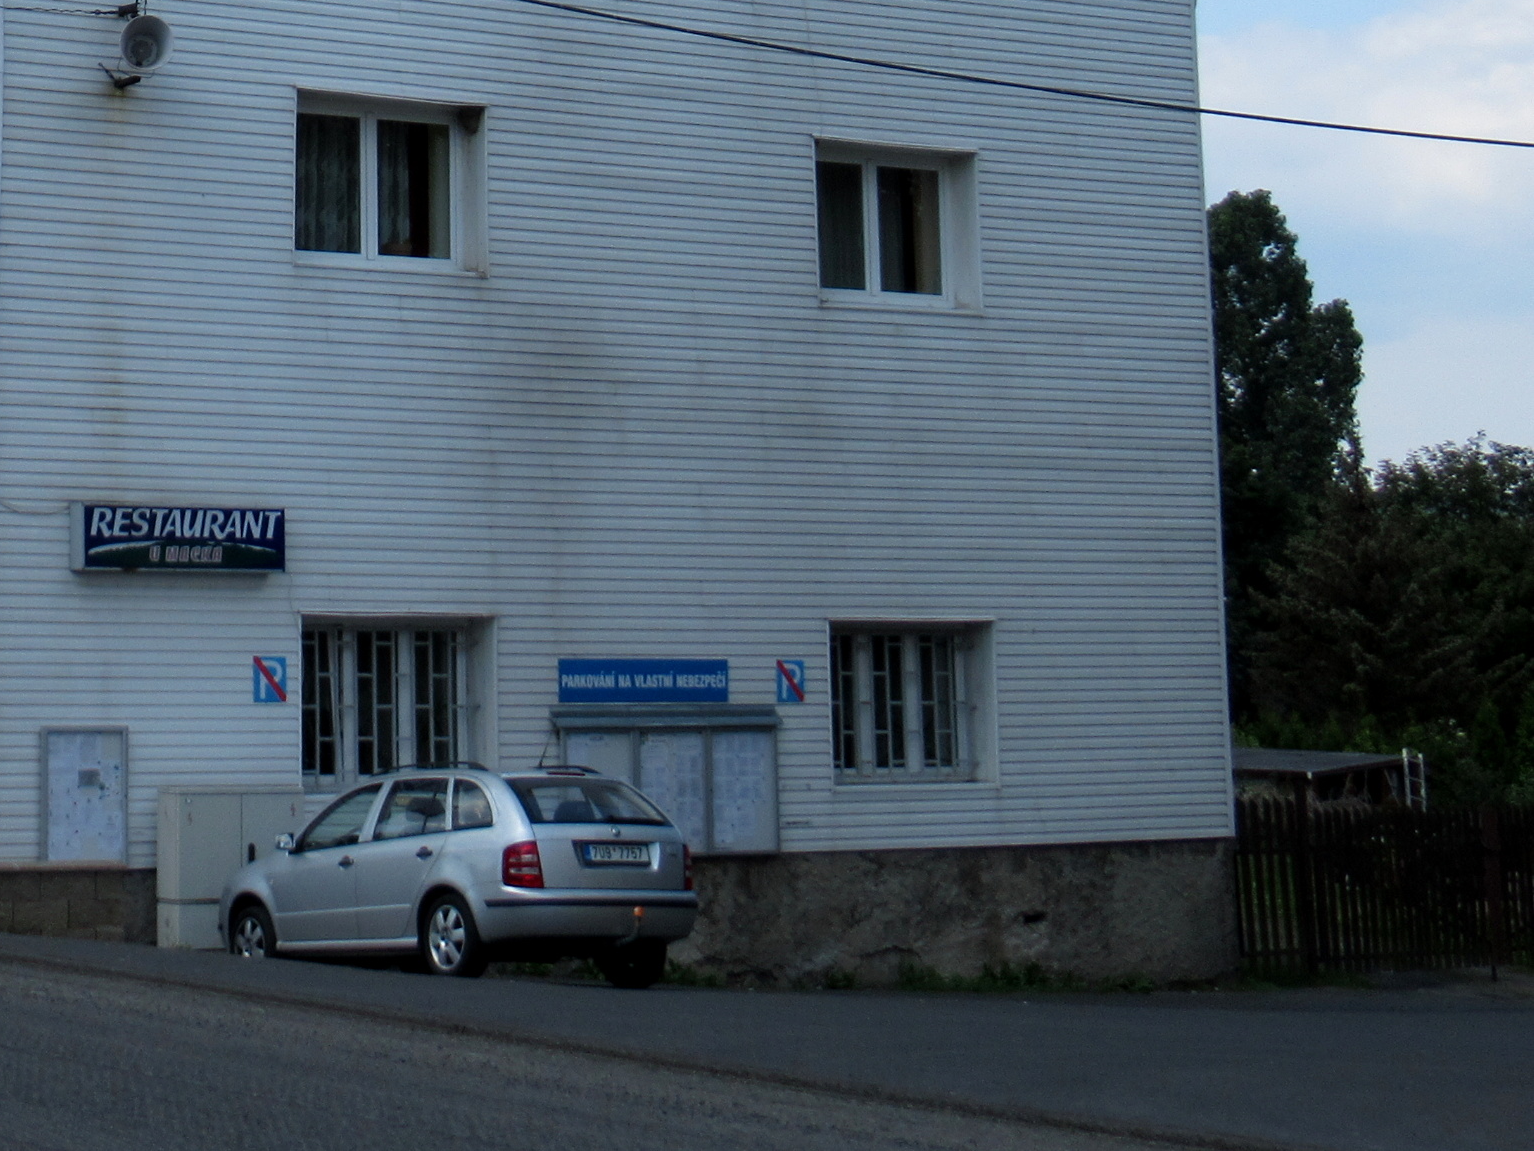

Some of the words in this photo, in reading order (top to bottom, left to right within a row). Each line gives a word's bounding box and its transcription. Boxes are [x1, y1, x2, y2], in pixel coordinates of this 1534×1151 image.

[90, 506, 281, 540] RESTAURANT
[561, 670, 615, 688] PARKOVÁNÍ
[618, 674, 632, 688] NA
[634, 670, 673, 688] VLASTNÍ
[676, 670, 726, 688] NEBEZPEČÍ
